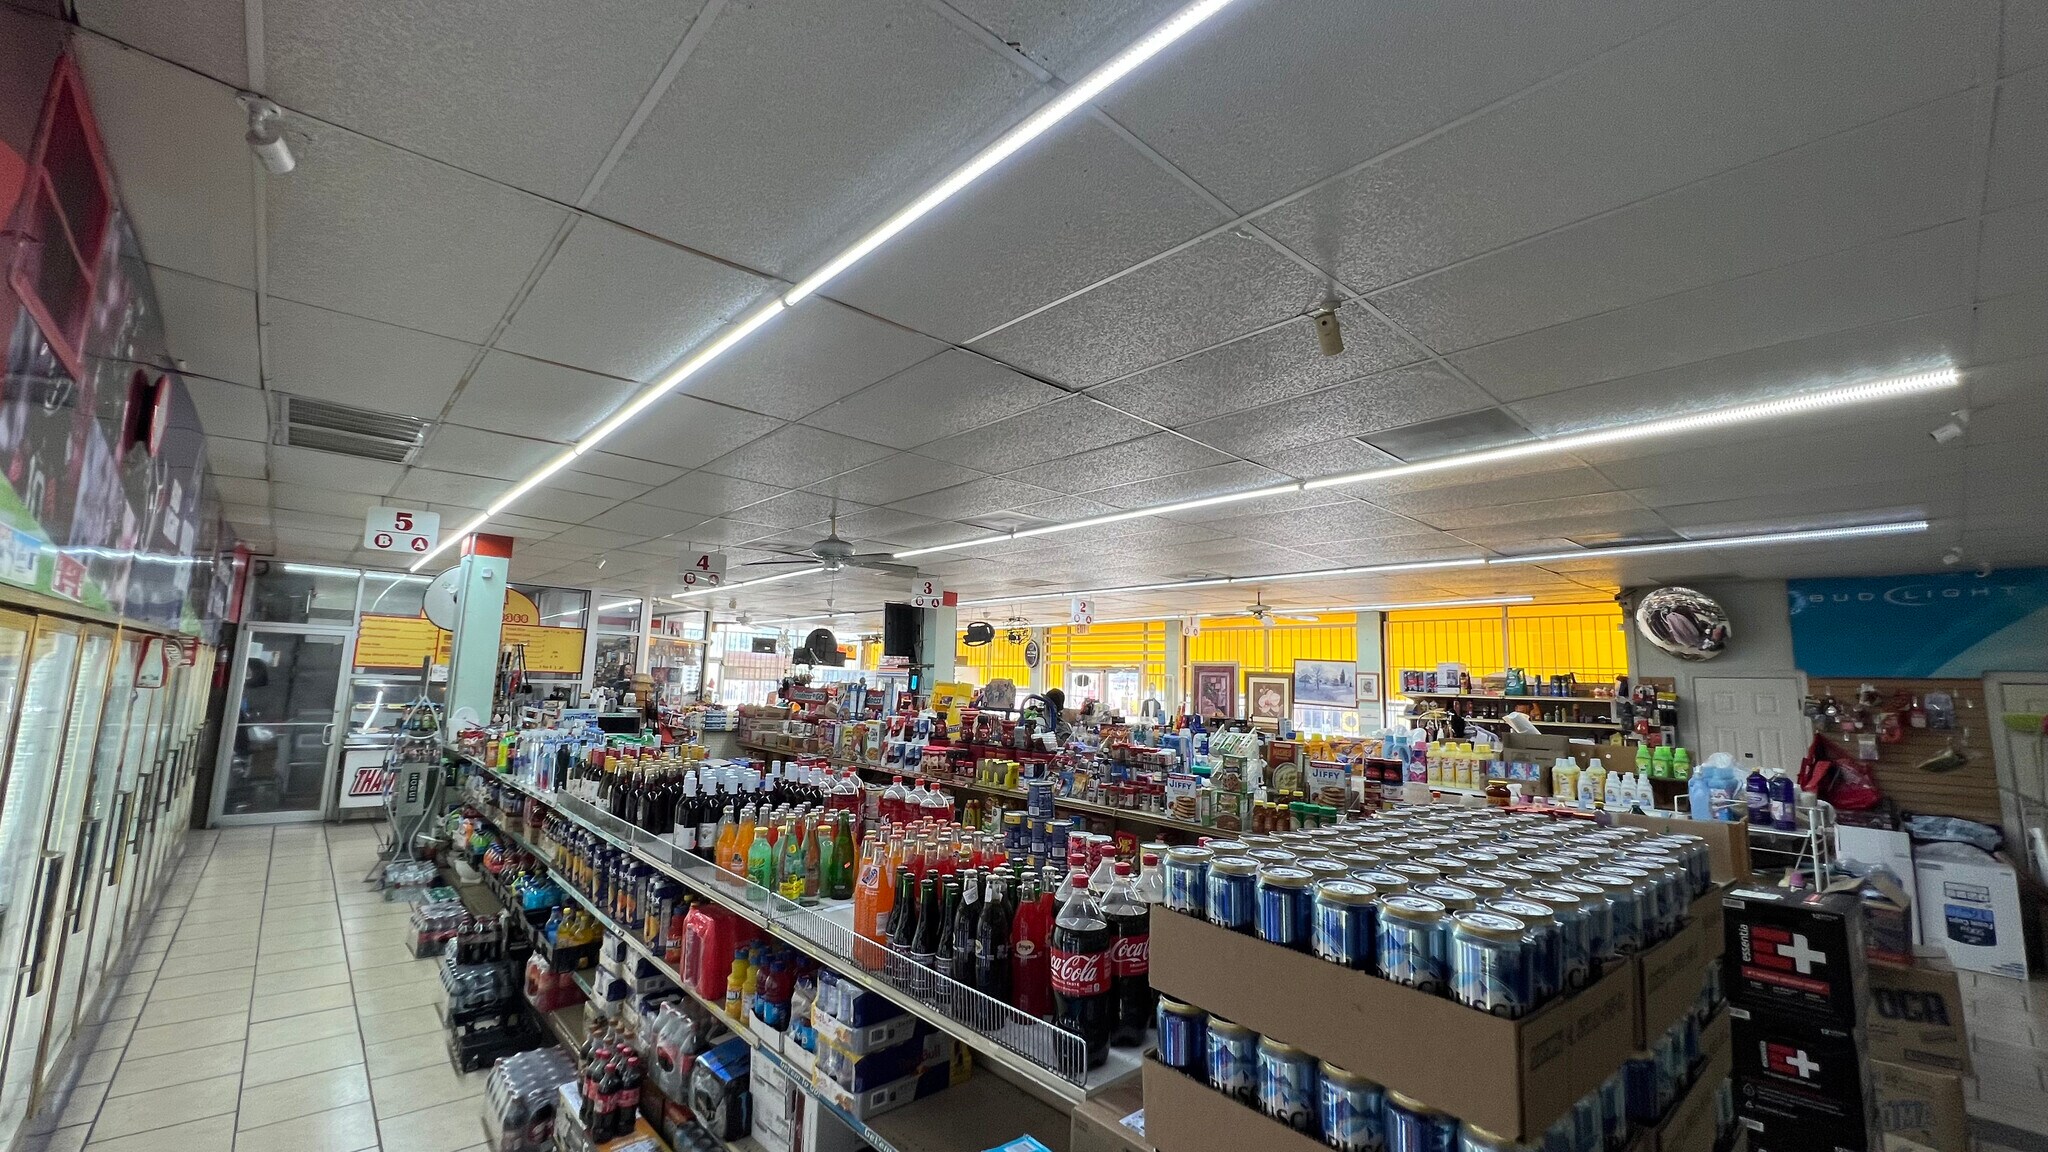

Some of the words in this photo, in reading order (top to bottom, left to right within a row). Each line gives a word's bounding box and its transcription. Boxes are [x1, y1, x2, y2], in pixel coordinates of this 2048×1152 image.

[395, 512, 413, 531] 5
[378, 535, 391, 547] B
[412, 538, 427, 550] A
[696, 555, 709, 570] 4
[924, 581, 932, 594] 3
[1809, 593, 1875, 602] BUD
[1904, 586, 2017, 600] LIGHT
[1080, 602, 1086, 612] 2
[1313, 769, 1340, 779] JIFFY
[1169, 779, 1192, 789] JIFFY
[1739, 924, 1751, 962] essentia
[1051, 954, 1100, 982] ca-Cola
